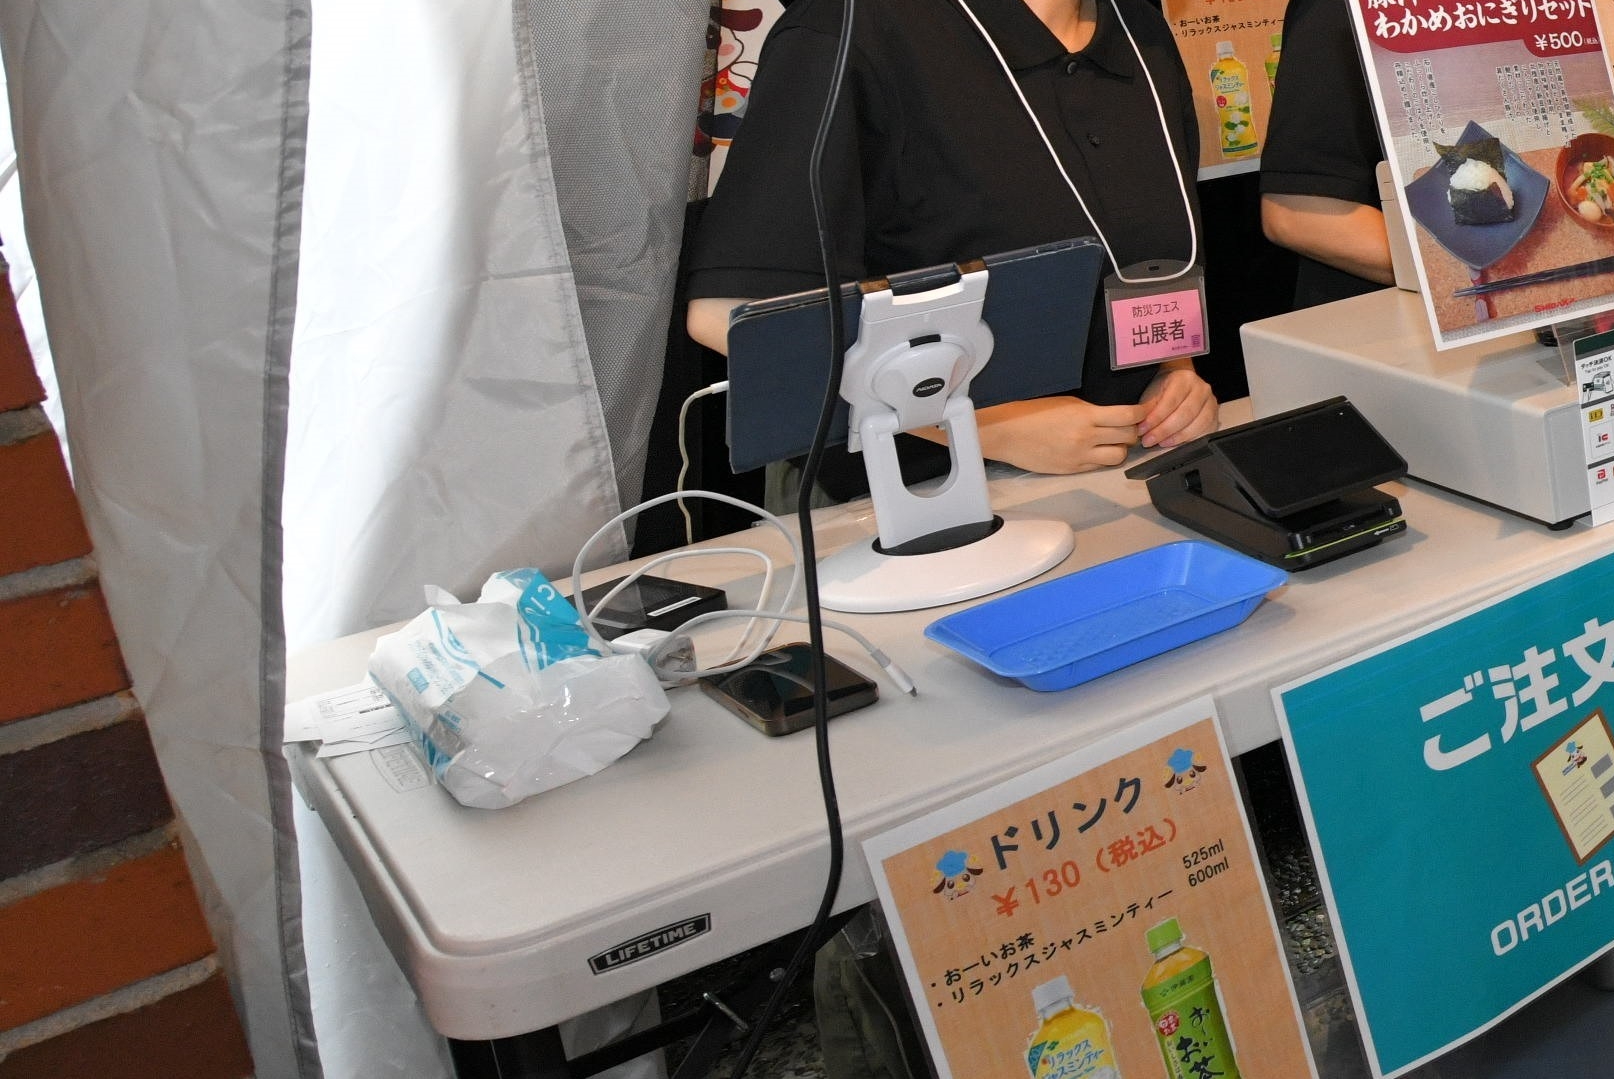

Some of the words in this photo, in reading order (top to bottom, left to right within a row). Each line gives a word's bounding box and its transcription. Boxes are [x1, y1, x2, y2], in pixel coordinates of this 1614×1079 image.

[1132, 301, 1180, 318] 防災フェス
[1132, 319, 1186, 347] 出展者
[989, 776, 1142, 871] ドリンク
[1182, 838, 1225, 870] 525ml
[1188, 857, 1231, 889] 600ml
[604, 922, 697, 967] LIFETIME
